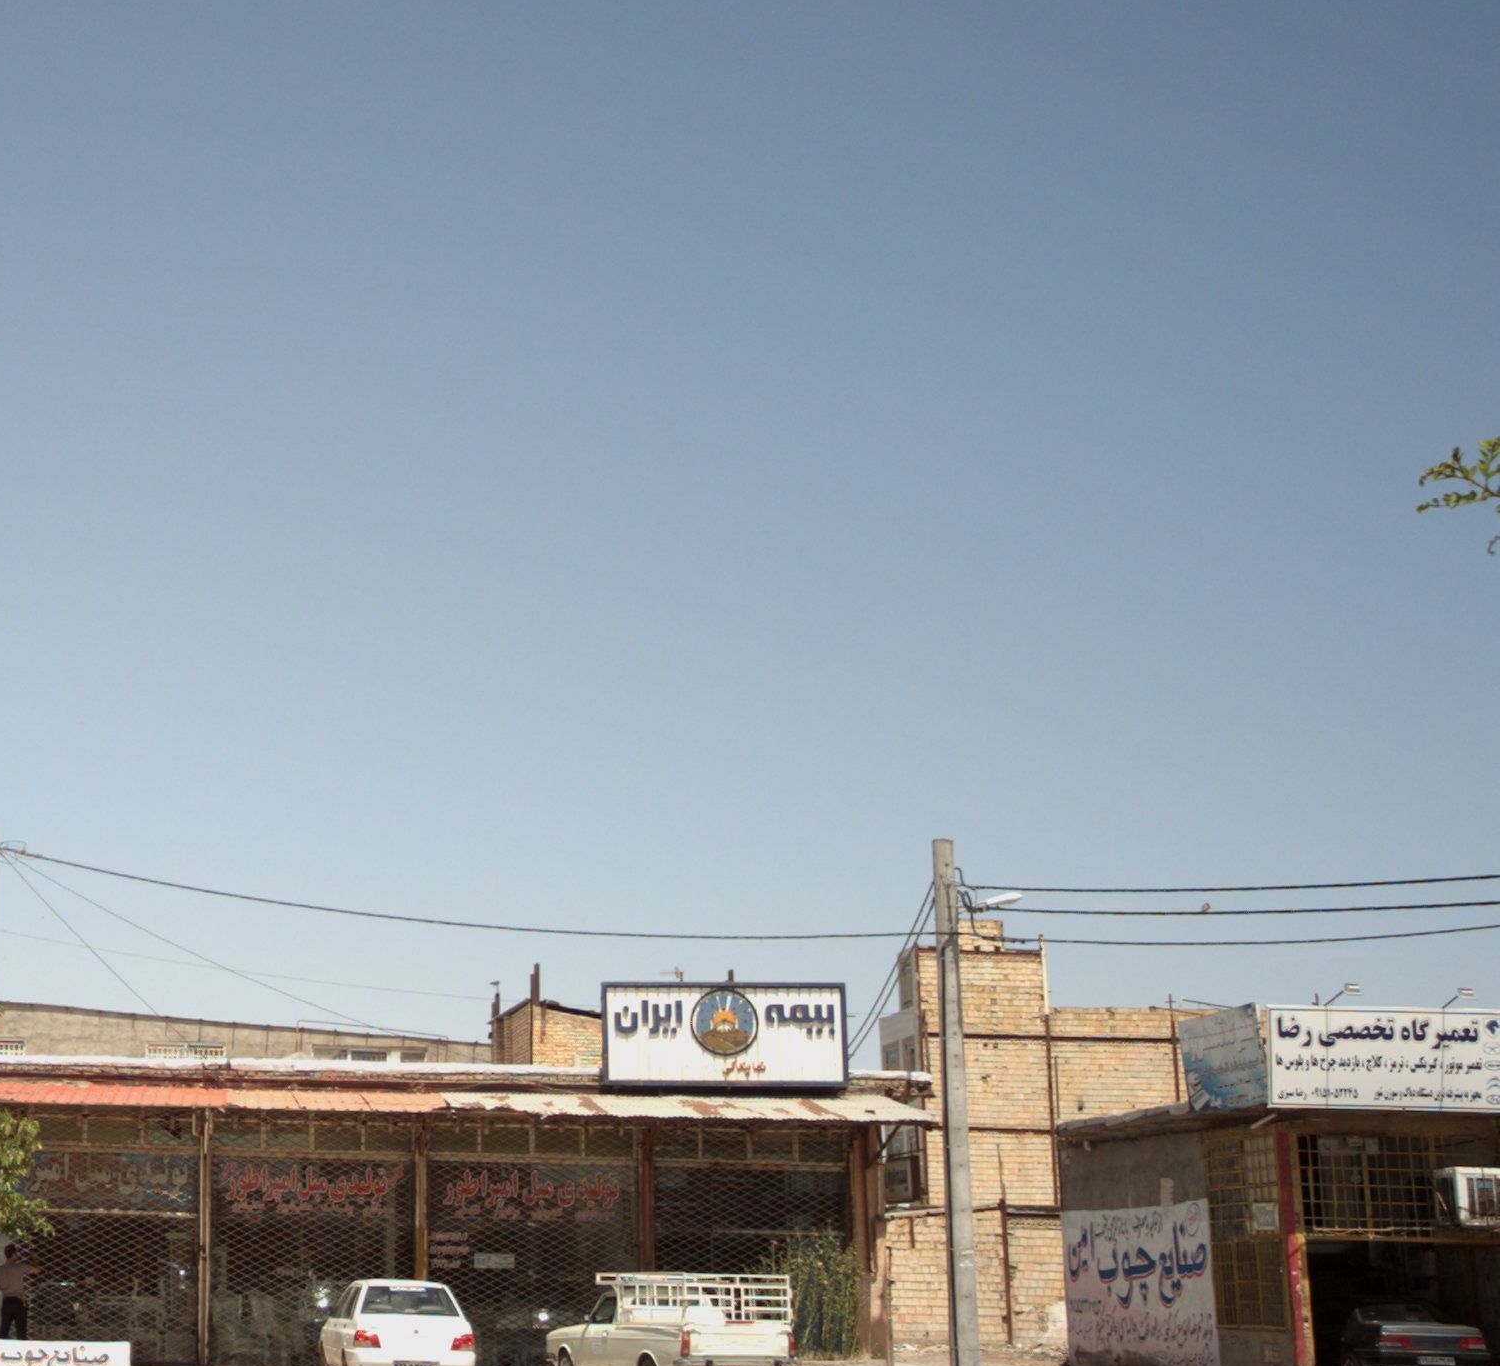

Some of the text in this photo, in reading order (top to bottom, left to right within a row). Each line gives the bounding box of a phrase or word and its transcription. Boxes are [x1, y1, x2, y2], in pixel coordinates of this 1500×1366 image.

[614, 1000, 836, 1037] بیمه ایران
[1276, 1016, 1312, 1047] رضا
[1319, 1017, 1395, 1047] تخصصی
[1067, 1221, 1096, 1284] امین
[1097, 1244, 1157, 1310] چوب
[1159, 1221, 1208, 1309] صنایع
